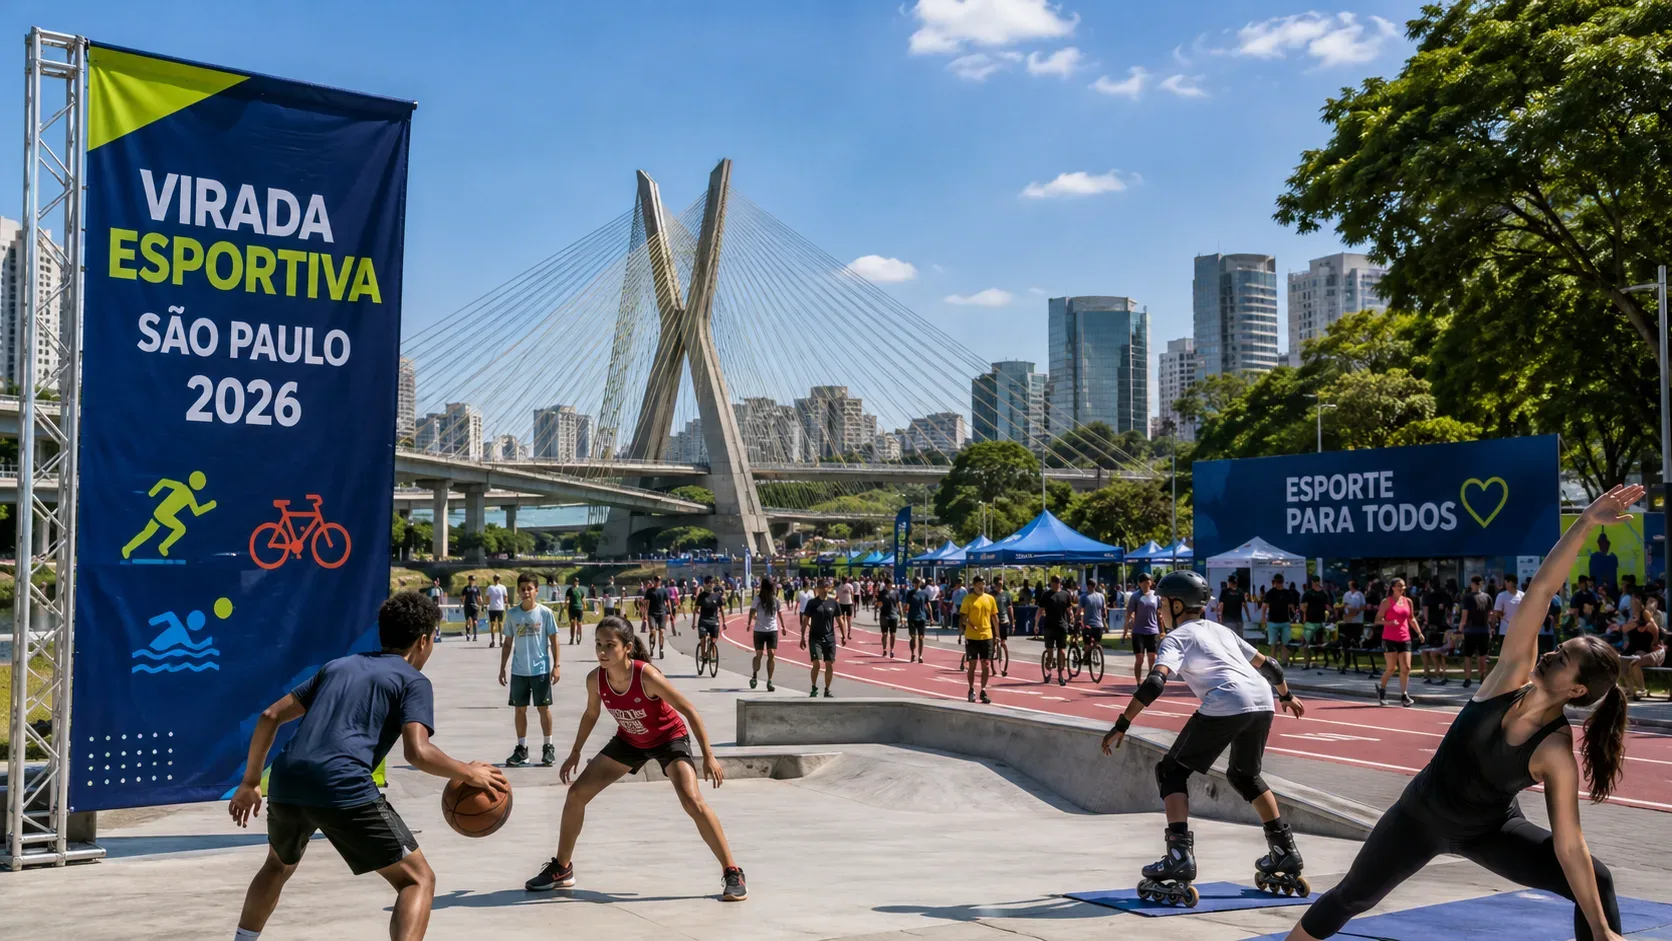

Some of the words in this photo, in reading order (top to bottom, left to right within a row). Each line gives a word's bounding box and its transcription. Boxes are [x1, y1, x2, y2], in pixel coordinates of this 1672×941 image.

[140, 168, 334, 243] VIRADA
[108, 227, 382, 304] ESPORTIVA
[137, 305, 219, 358] SÃO
[229, 320, 351, 367] PAULO
[186, 374, 302, 427] 2026
[1286, 471, 1394, 502] ESPORTE
[1286, 506, 1354, 534] PARA
[1362, 501, 1457, 532] TODOS
